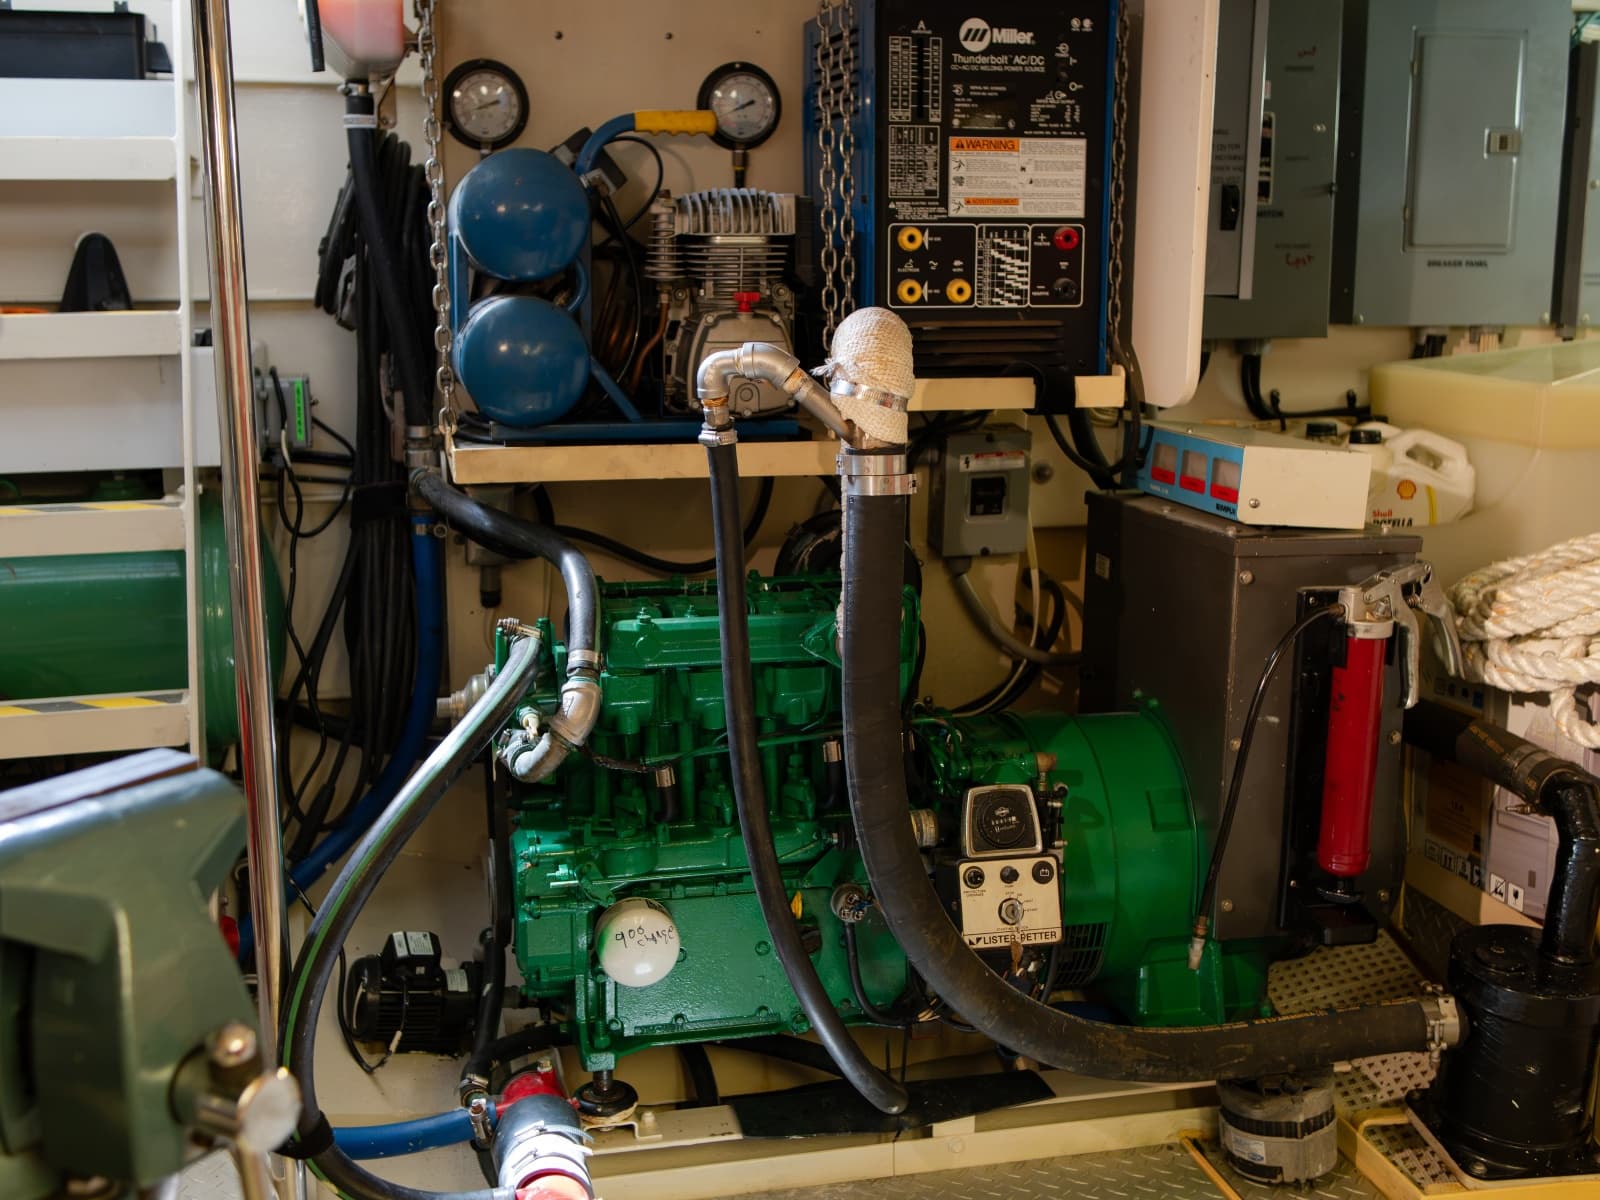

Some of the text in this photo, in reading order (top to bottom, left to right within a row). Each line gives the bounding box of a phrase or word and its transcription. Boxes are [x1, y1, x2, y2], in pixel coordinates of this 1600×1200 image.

[992, 27, 1034, 45] Miller
[952, 54, 1045, 66] Thunderbolt AC/DC
[966, 139, 1015, 150] WARNING
[1372, 508, 1393, 518] Shell
